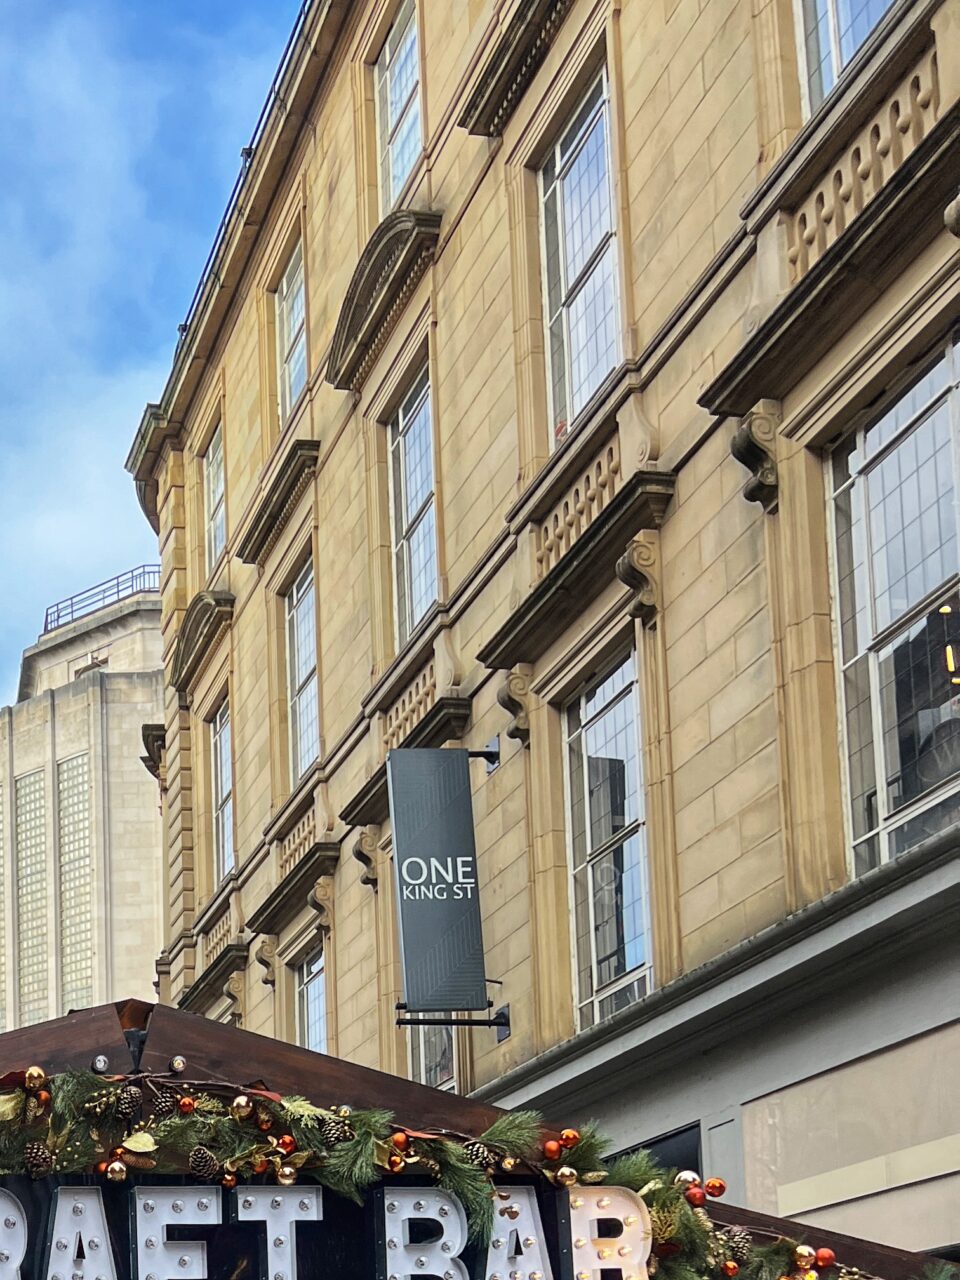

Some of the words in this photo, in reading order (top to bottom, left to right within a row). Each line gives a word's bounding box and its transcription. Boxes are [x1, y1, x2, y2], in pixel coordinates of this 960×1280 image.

[401, 856, 475, 884] ONE
[402, 885, 447, 900] KING
[453, 883, 475, 899] ST
